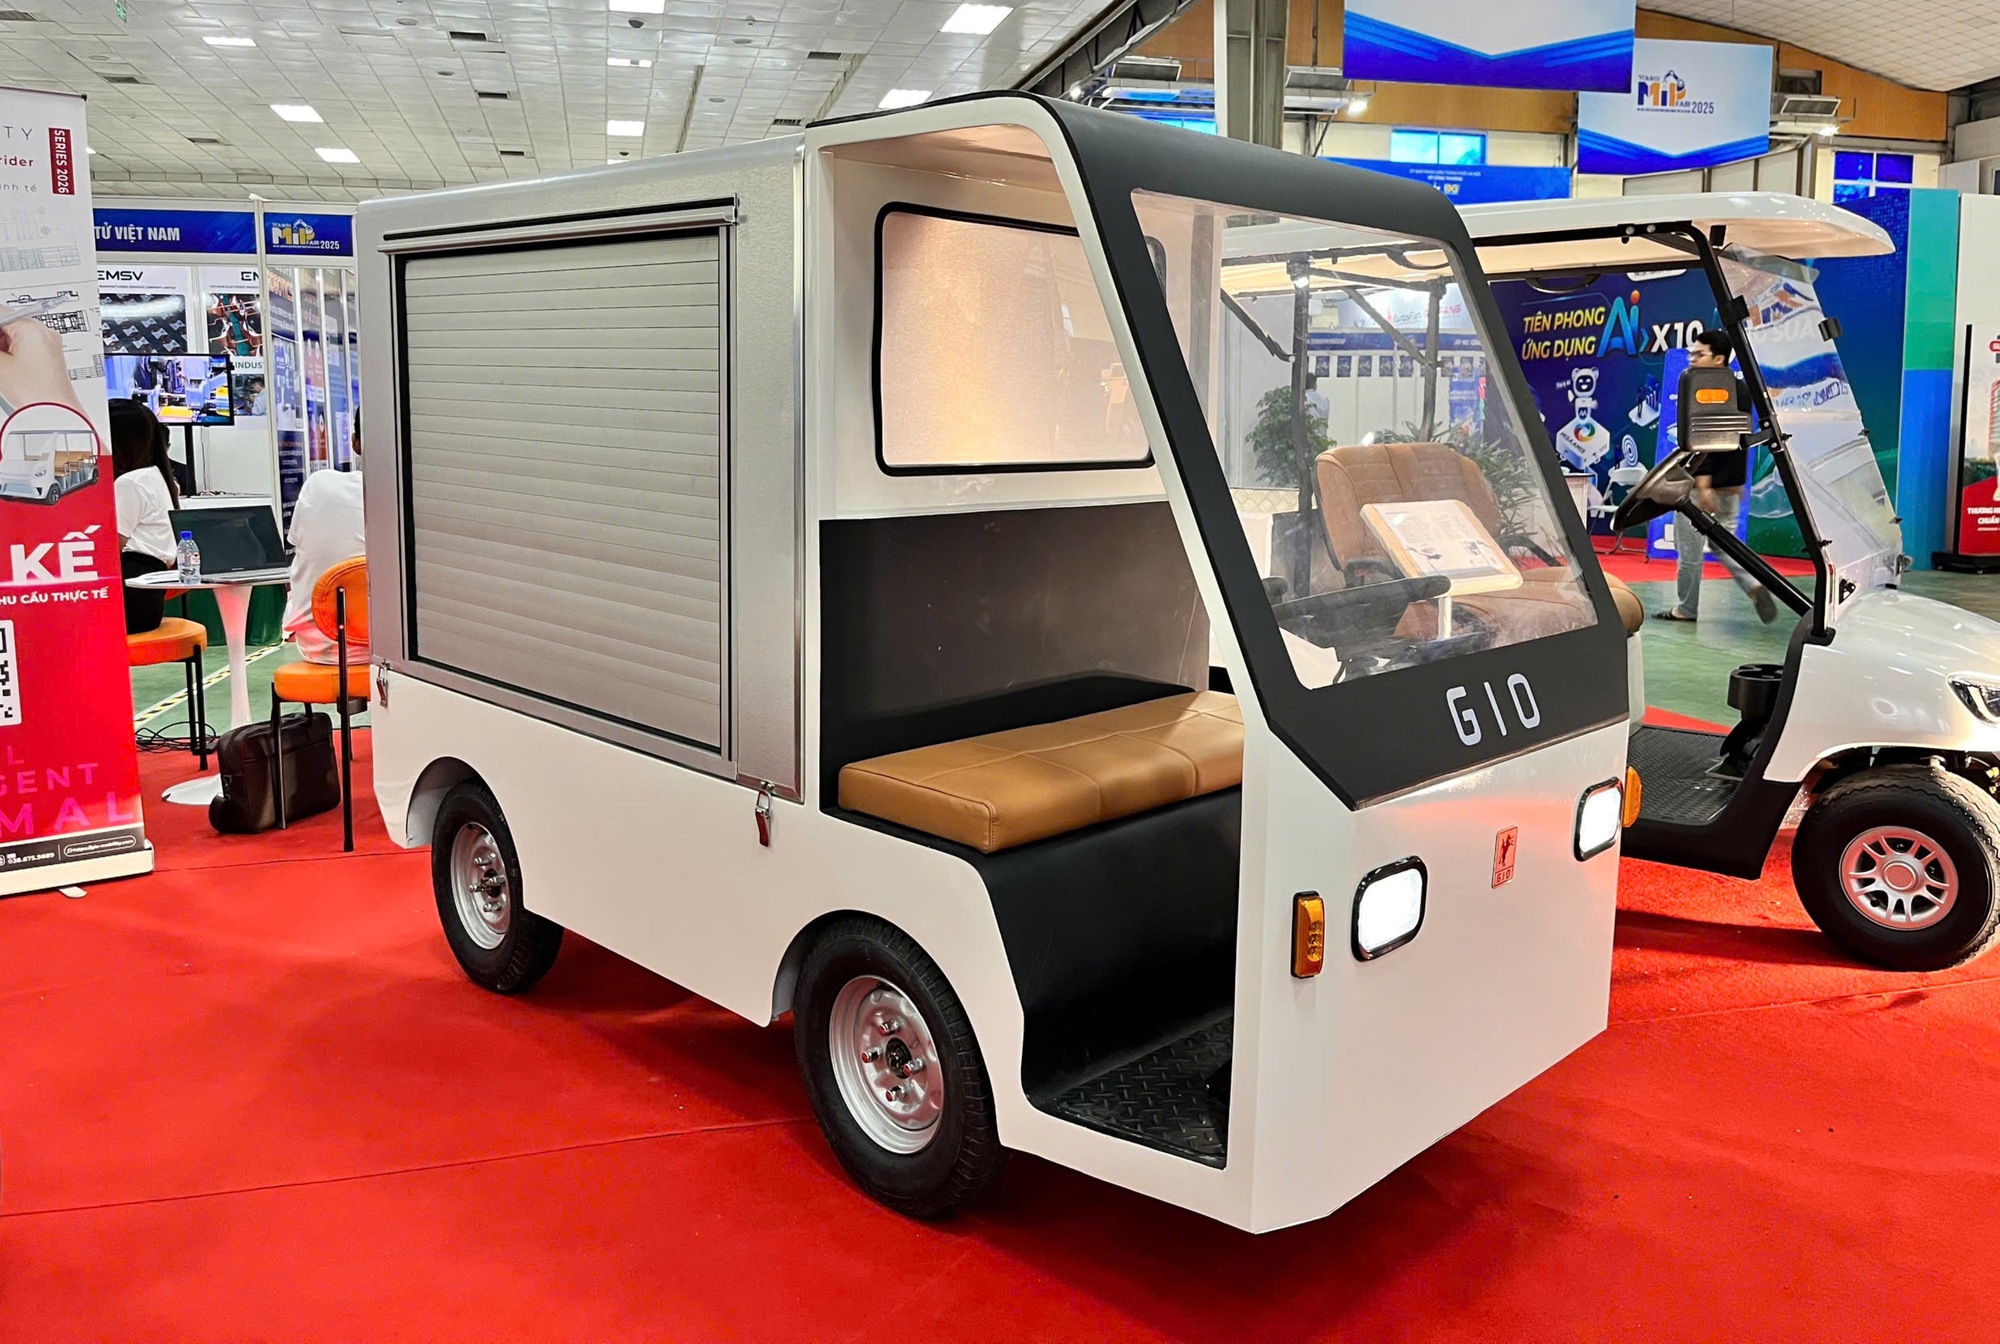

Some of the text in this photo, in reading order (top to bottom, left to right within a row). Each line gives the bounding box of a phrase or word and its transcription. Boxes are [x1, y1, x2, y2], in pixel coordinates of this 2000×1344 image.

[1692, 102, 1714, 114] 2025
[54, 129, 69, 194] SERIES 2026
[94, 222, 180, 243] TỬ VIỆT NAM
[320, 240, 340, 249] 2025
[1523, 310, 1552, 334] TIÊN
[1553, 306, 1606, 331] PHONG
[1521, 335, 1597, 361] ỨNG DỤNG
[235, 361, 263, 369] INDUS
[10, 525, 101, 583] KẾ
[51, 590, 89, 603] THỰC
[91, 586, 109, 599] TẾ
[1446, 673, 1541, 746] GIO
[1496, 869, 1511, 883] GIO
